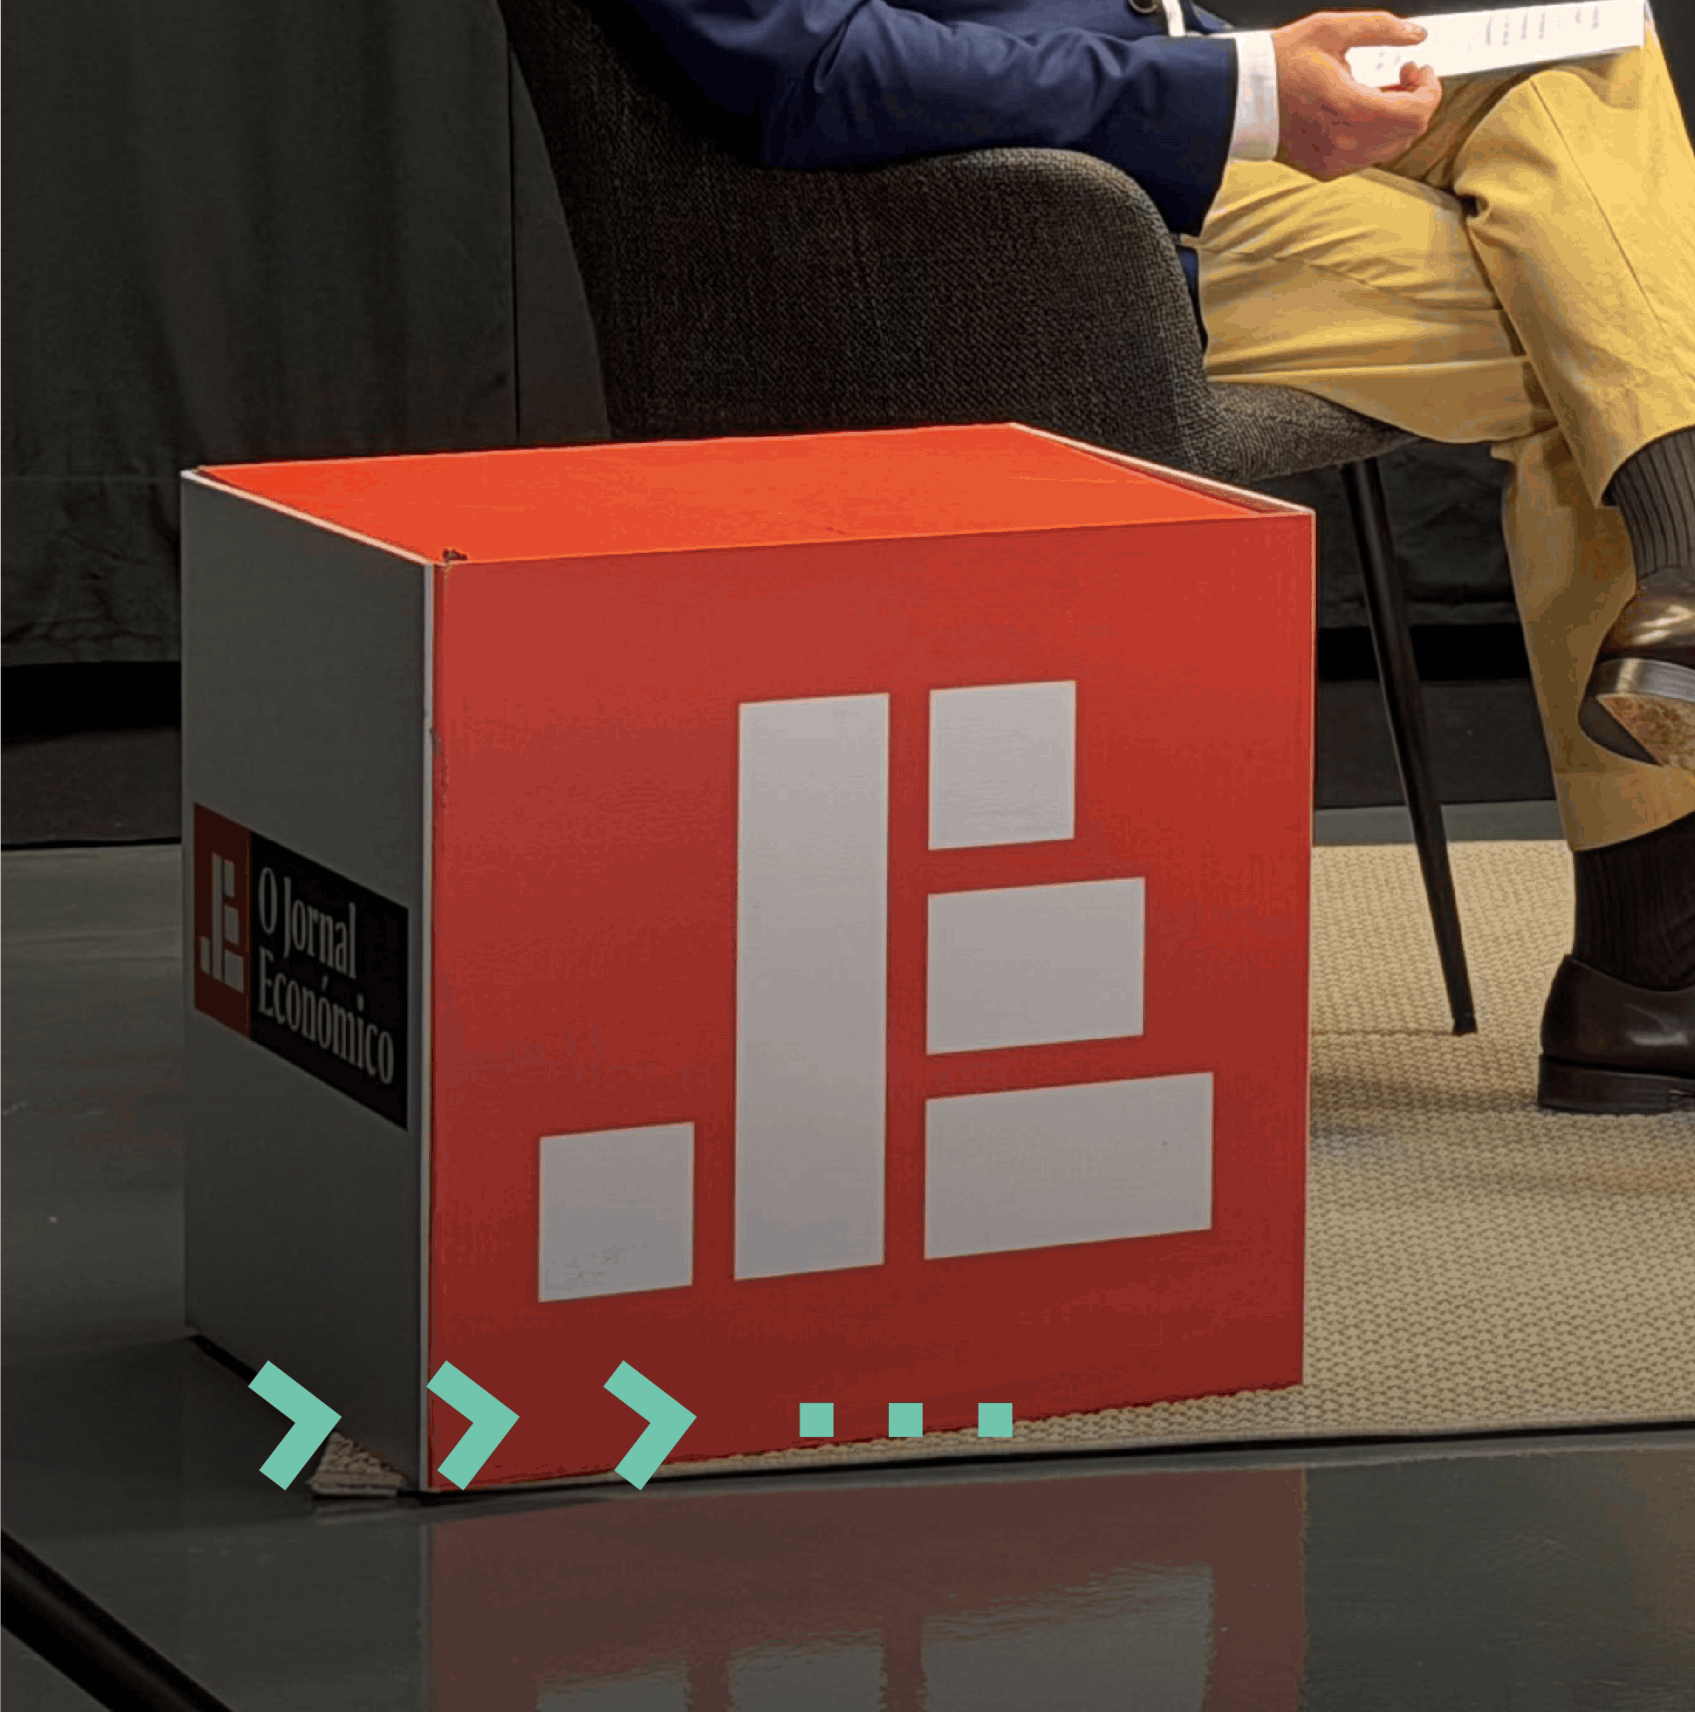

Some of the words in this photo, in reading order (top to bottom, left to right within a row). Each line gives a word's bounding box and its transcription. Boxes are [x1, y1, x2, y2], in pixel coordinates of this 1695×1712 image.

[258, 866, 278, 935] O
[283, 876, 356, 979] Jornal
[258, 946, 394, 1085] Económico
